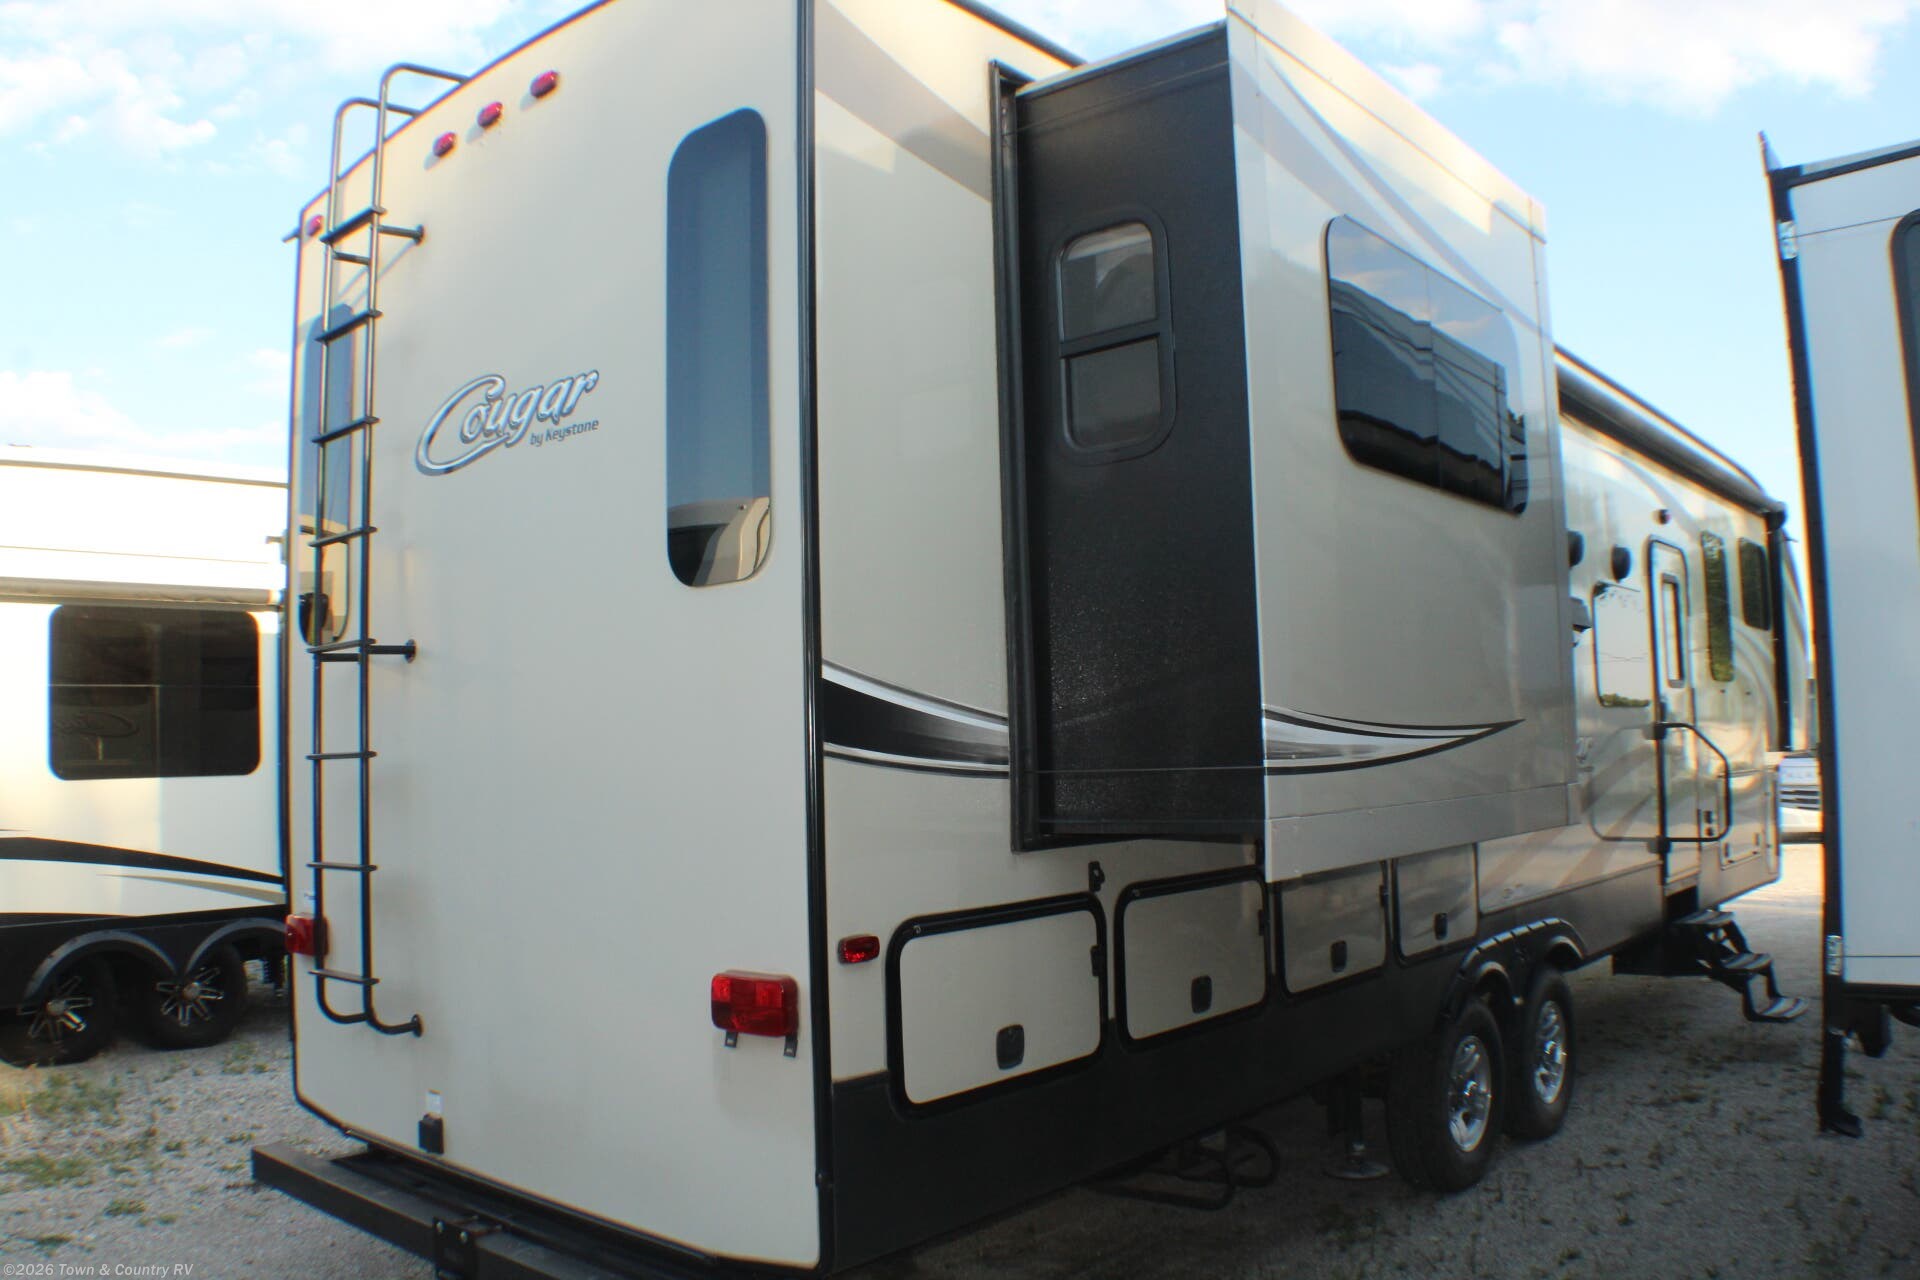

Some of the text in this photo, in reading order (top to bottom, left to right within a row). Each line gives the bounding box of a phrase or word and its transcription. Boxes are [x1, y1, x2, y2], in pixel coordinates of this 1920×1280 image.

[414, 369, 600, 477] Cougar
[529, 420, 600, 447] by Keystone
